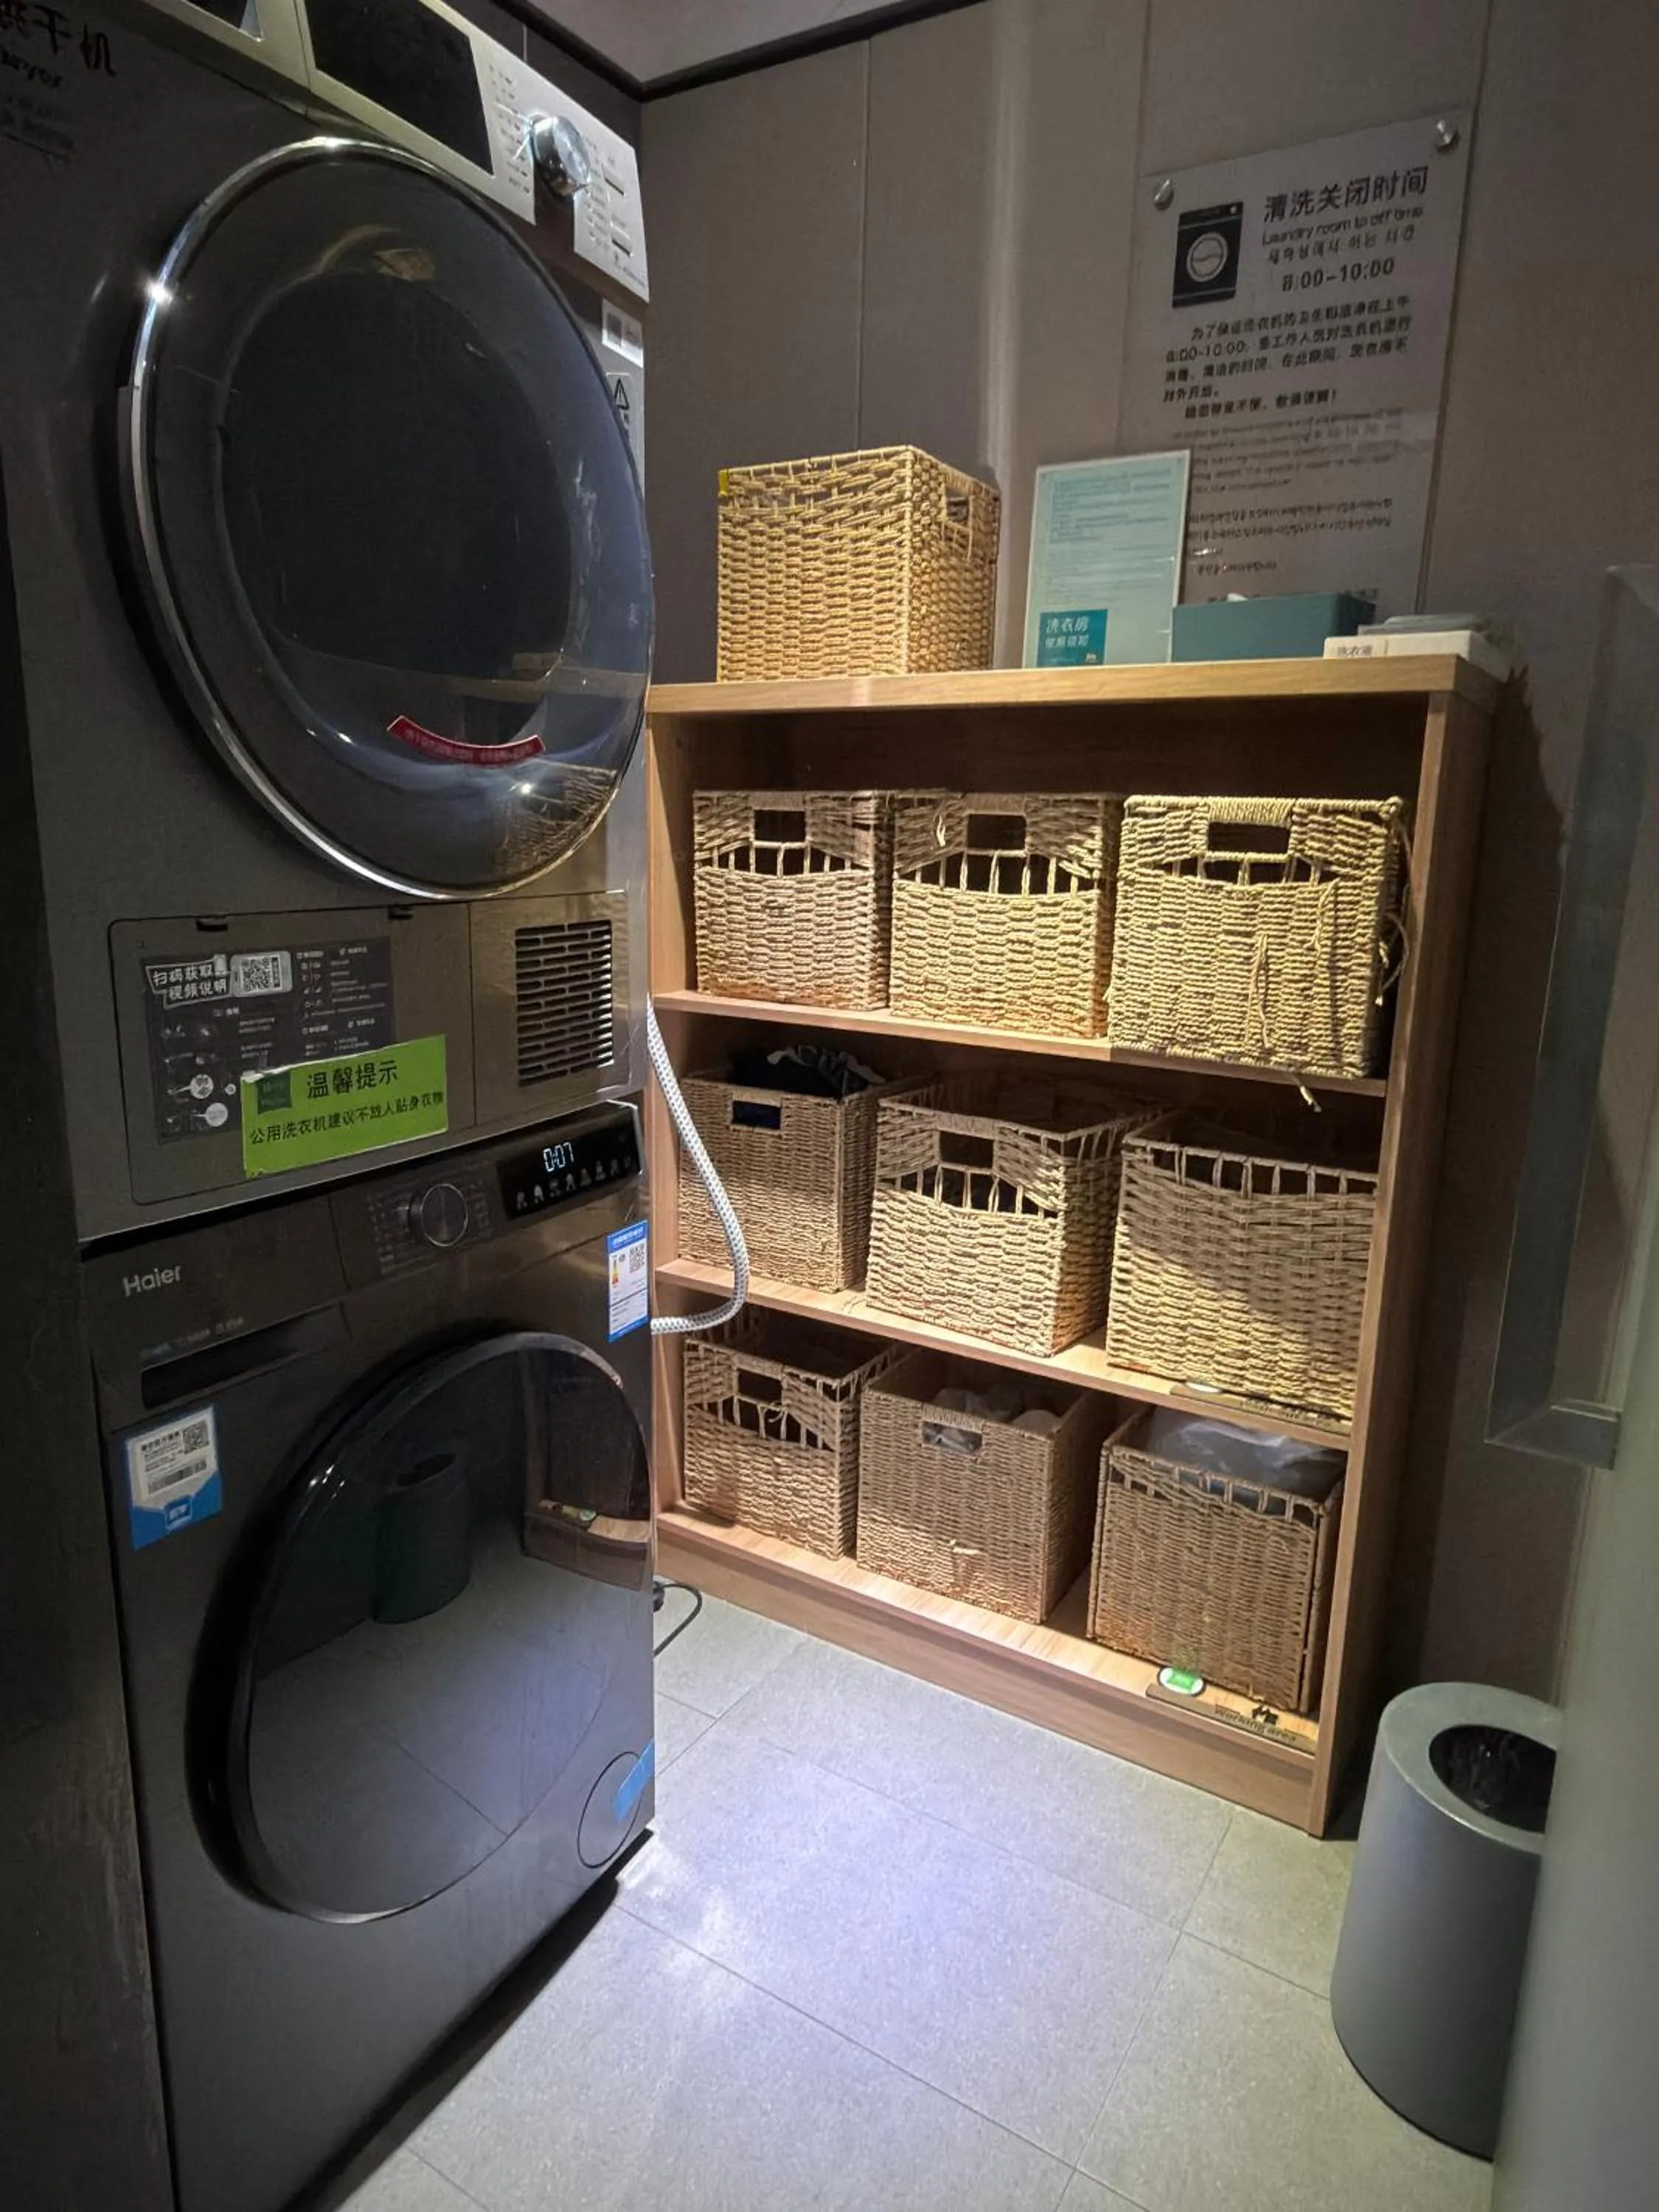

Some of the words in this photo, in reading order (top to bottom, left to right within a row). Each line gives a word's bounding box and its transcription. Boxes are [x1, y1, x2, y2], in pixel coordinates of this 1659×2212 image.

[1264, 166, 1428, 223] 清洗关闭时间
[1316, 218, 1352, 235] room
[1046, 615, 1090, 634] 洗衣房
[152, 963, 213, 987] 扫码获取
[306, 1059, 399, 1099] 温馨提示
[542, 1141, 575, 1172] 0:07
[121, 1265, 182, 1298] Haier
